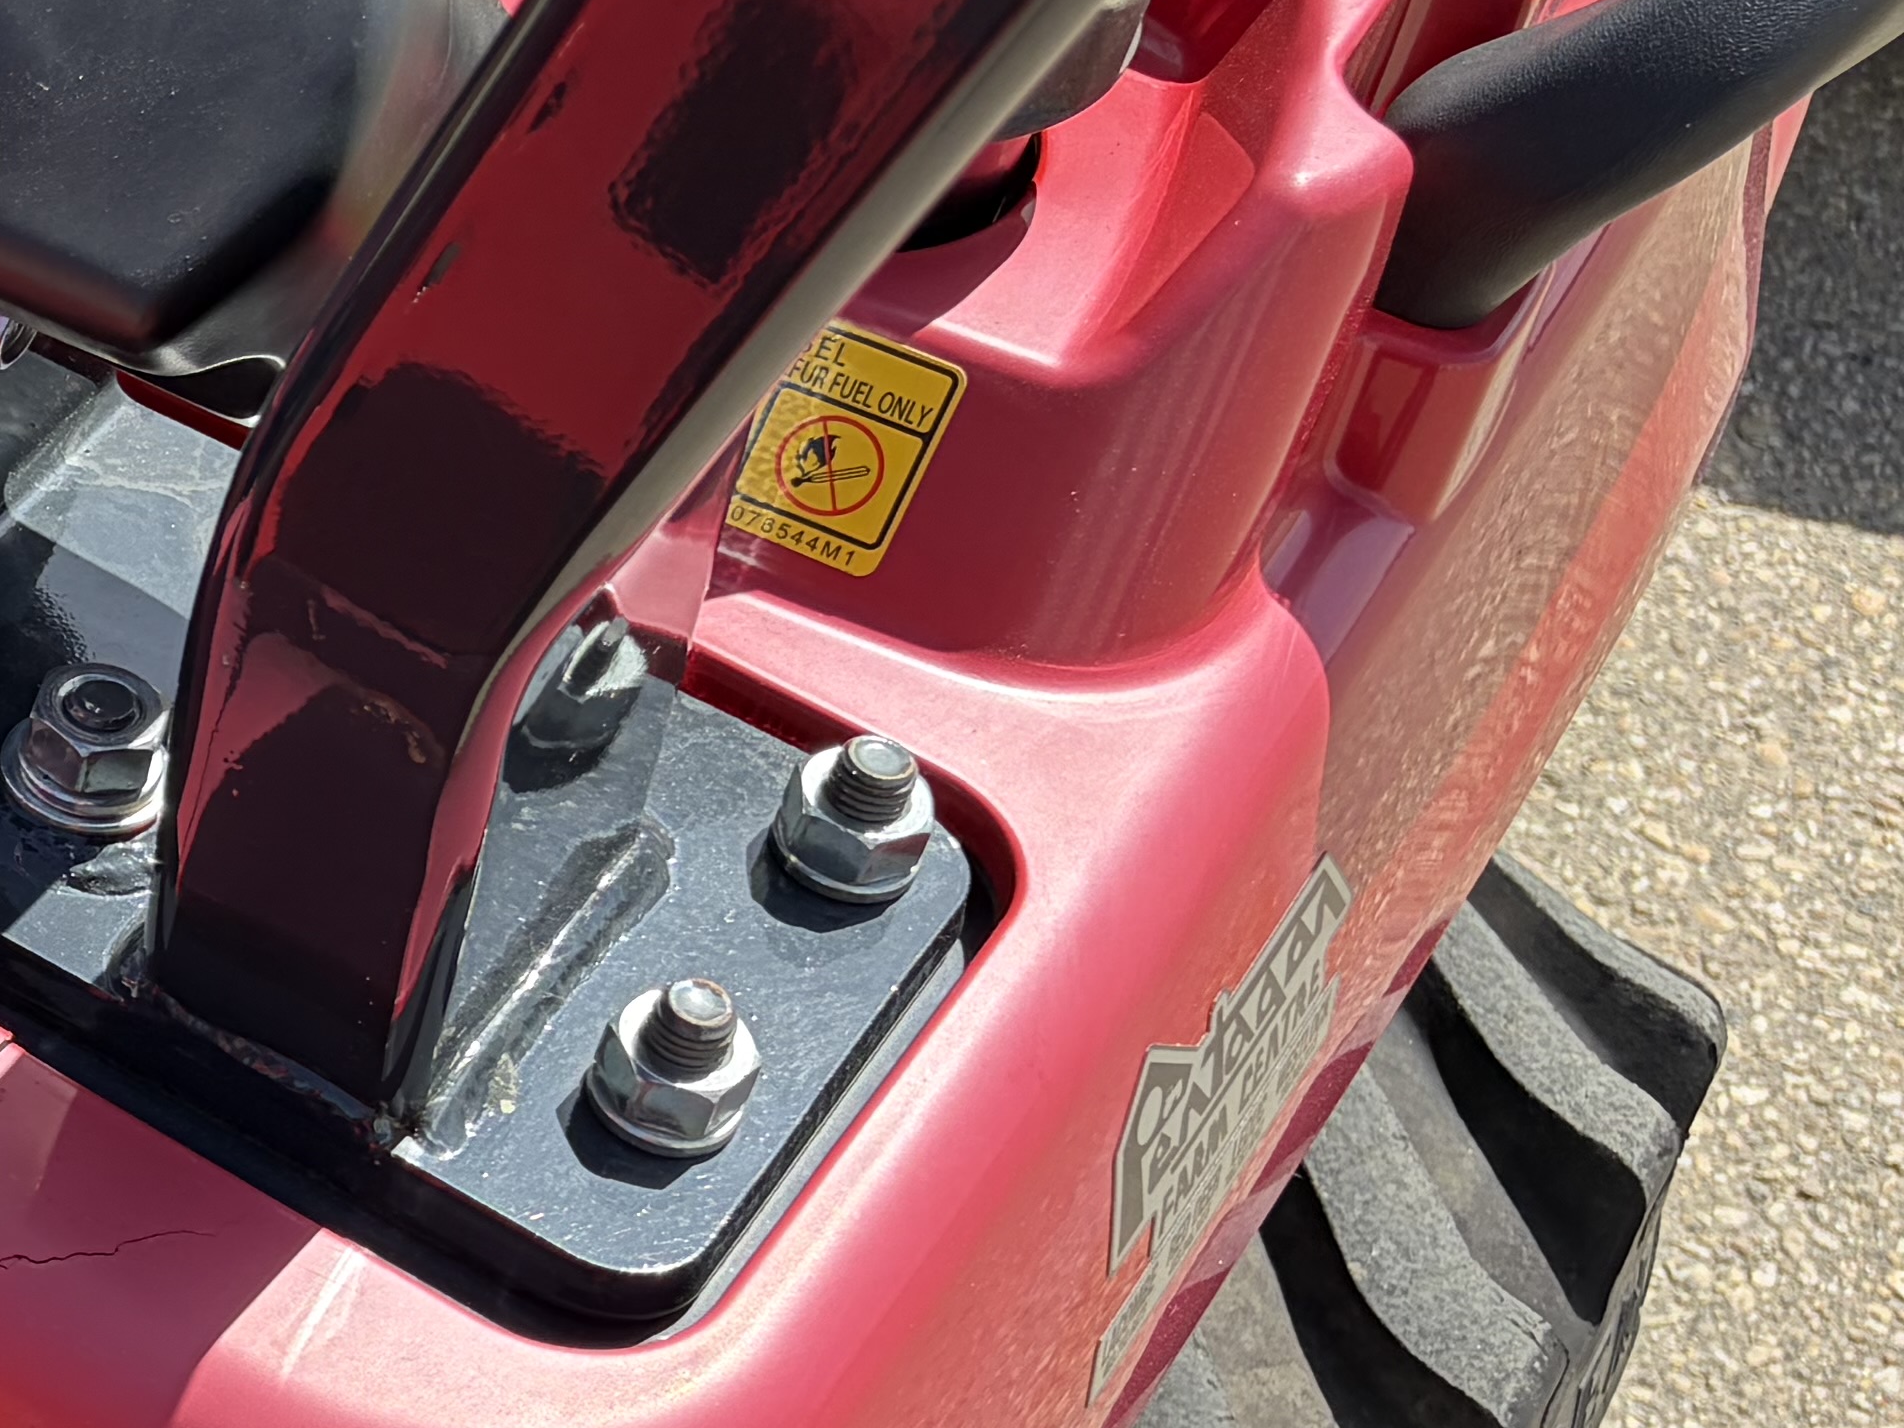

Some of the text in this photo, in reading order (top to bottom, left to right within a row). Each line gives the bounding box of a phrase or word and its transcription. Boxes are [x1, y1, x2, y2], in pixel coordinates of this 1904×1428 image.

[788, 357, 934, 429] FUR FUEL ONLY
[1158, 958, 1323, 1232] FARM CENTRE
